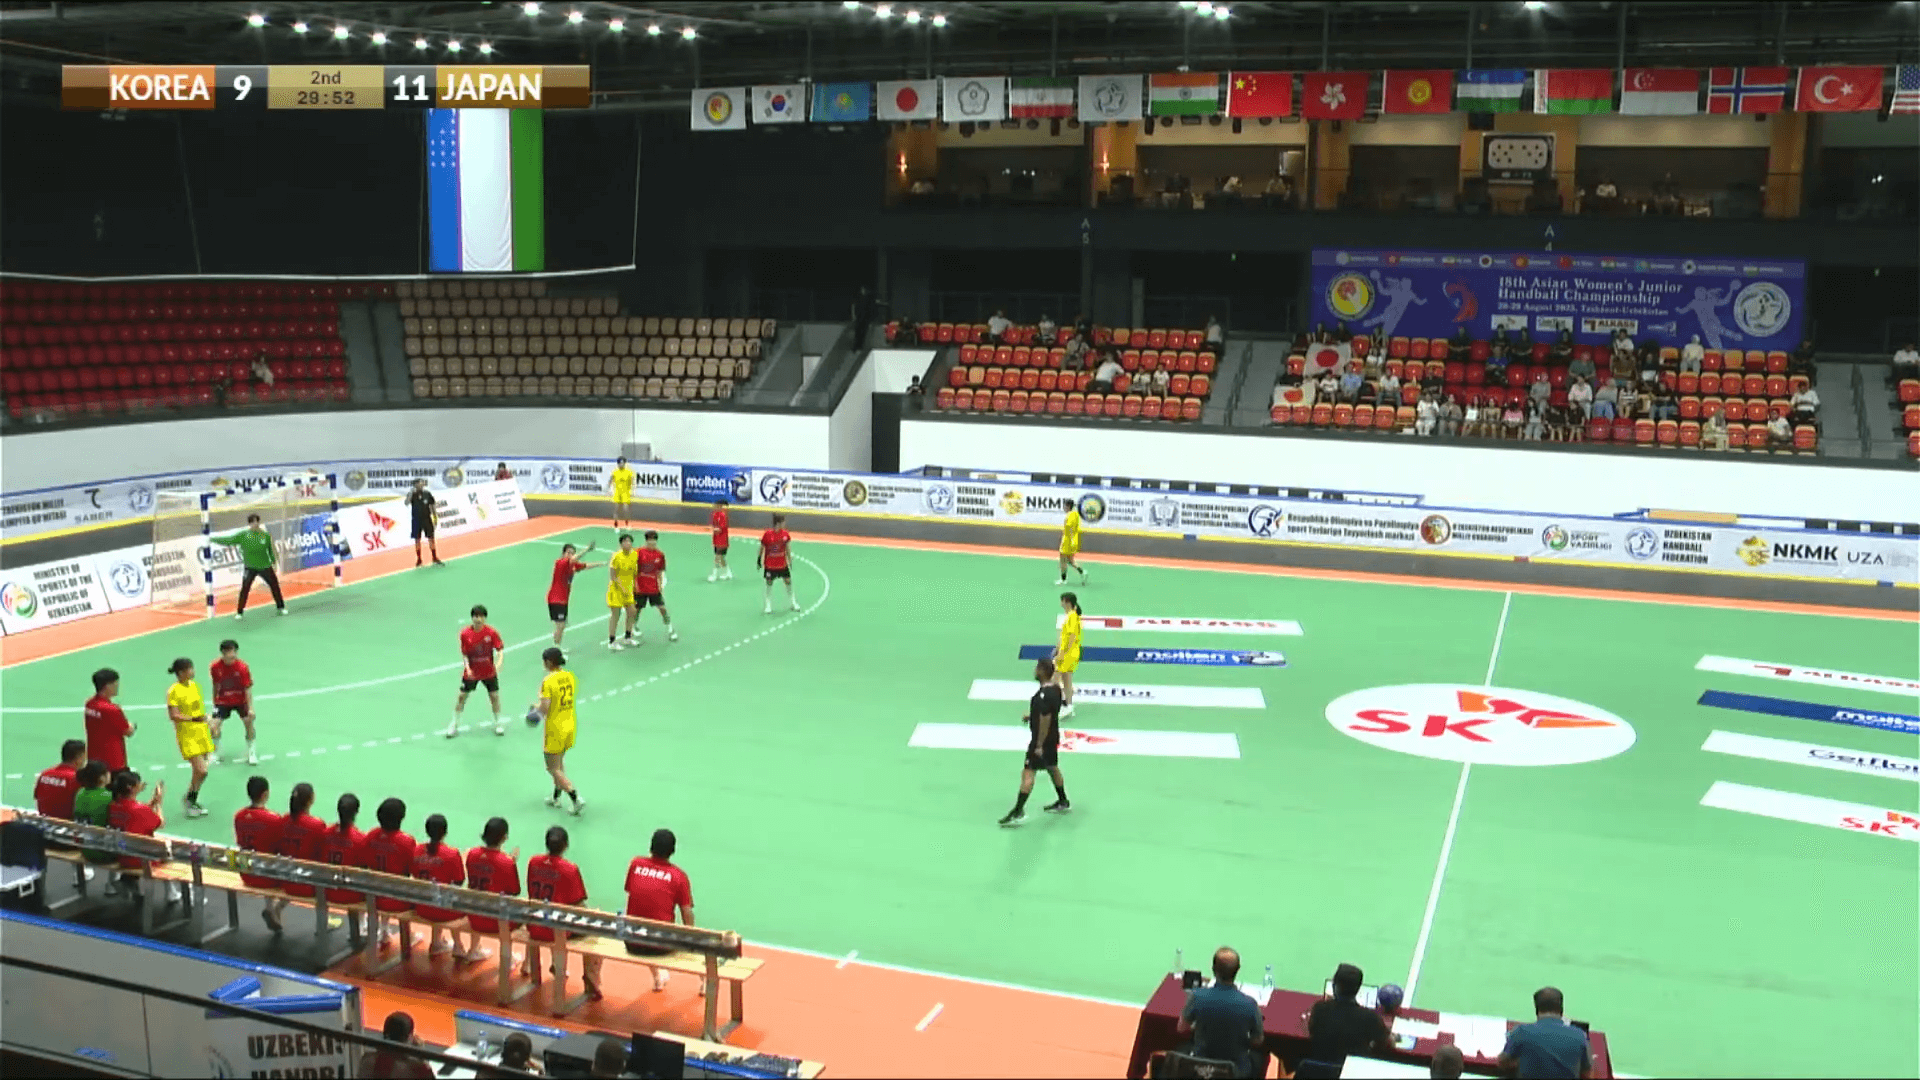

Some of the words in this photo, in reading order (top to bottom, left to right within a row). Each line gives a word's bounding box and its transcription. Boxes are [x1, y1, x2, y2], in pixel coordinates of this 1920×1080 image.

[1499, 276, 1526, 289] 18th
[1532, 277, 1568, 290] Asian
[1574, 277, 1633, 291] Women's
[1638, 280, 1683, 293] Junior
[1498, 288, 1558, 301] Handball
[1564, 289, 1660, 306] Championship
[636, 473, 678, 487] NKMK
[686, 475, 726, 489] molten
[363, 531, 386, 551] SK
[1664, 529, 1712, 541] UZBEKISTAN
[1663, 541, 1703, 552] HANDBALL
[1773, 543, 1839, 561] NKMK
[1662, 552, 1709, 564] FEDERATION
[1848, 552, 1884, 565] UZA
[33, 564, 70, 580] MINISTRY
[38, 580, 68, 593] SPORTS
[79, 574, 93, 585] THE
[80, 589, 89, 599] OF
[47, 602, 93, 619] UZBEKISTAN
[559, 685, 573, 707] 23
[1347, 709, 1496, 743] SK
[1840, 817, 1900, 836] SK
[634, 866, 672, 882] KOREA
